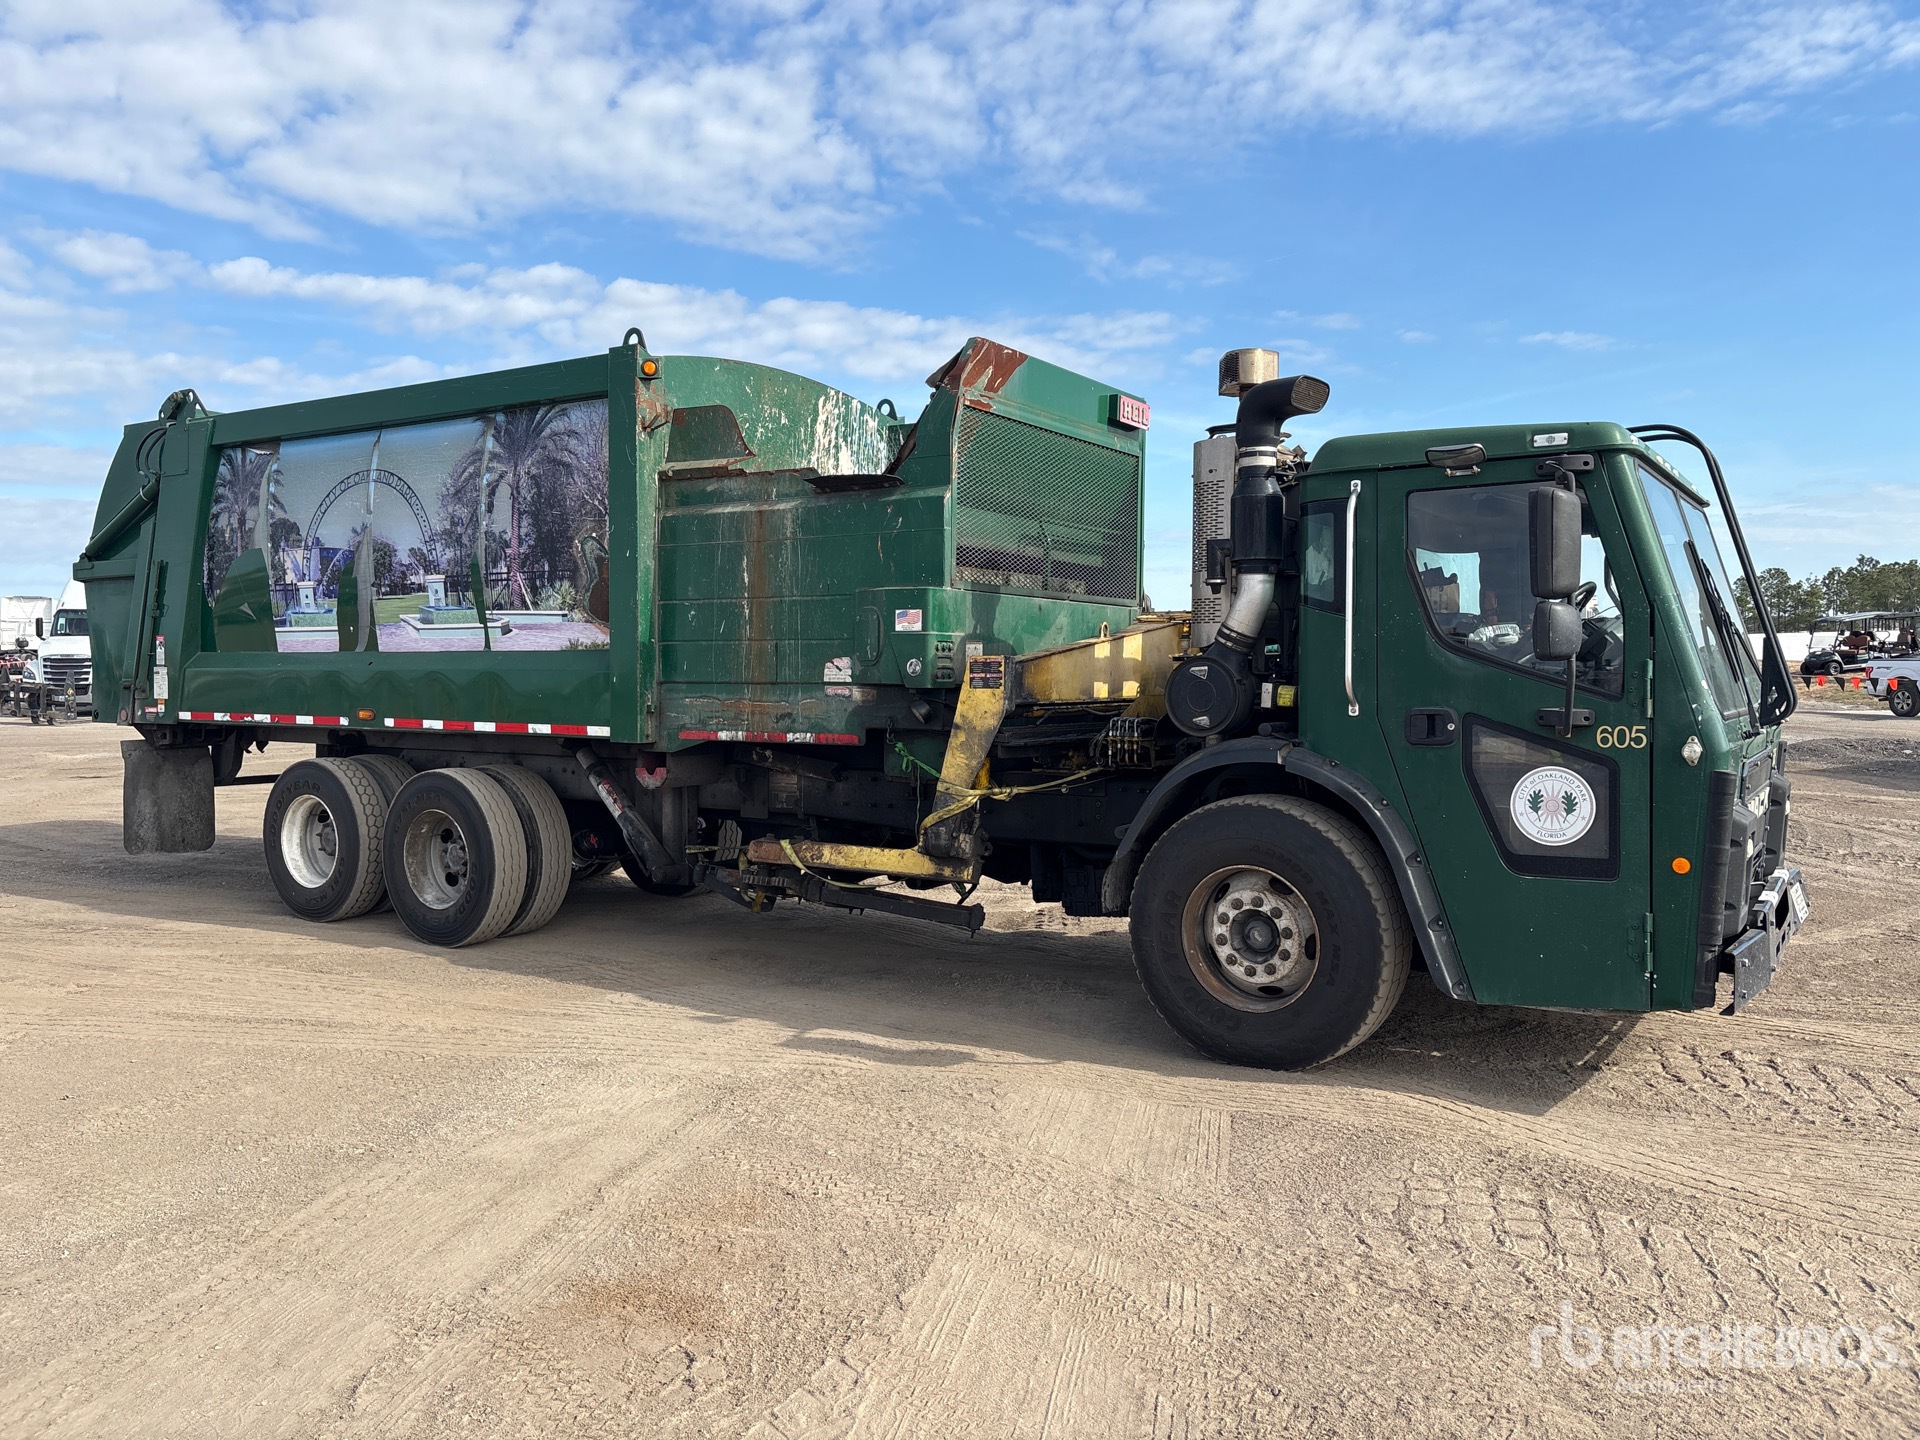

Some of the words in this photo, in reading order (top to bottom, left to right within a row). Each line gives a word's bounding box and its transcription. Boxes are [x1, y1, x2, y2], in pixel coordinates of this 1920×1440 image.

[1122, 400, 1149, 427] HEIL
[319, 486, 338, 514] CITY
[339, 476, 351, 492] OF
[395, 477, 417, 506] PARK
[1596, 725, 1648, 749] 605
[1518, 784, 1529, 800] CITY
[1537, 773, 1575, 785] OAKLAND
[1574, 784, 1588, 803] PARK
[270, 779, 321, 852] GOODYEAR
[1536, 830, 1568, 839] FLORIDA
